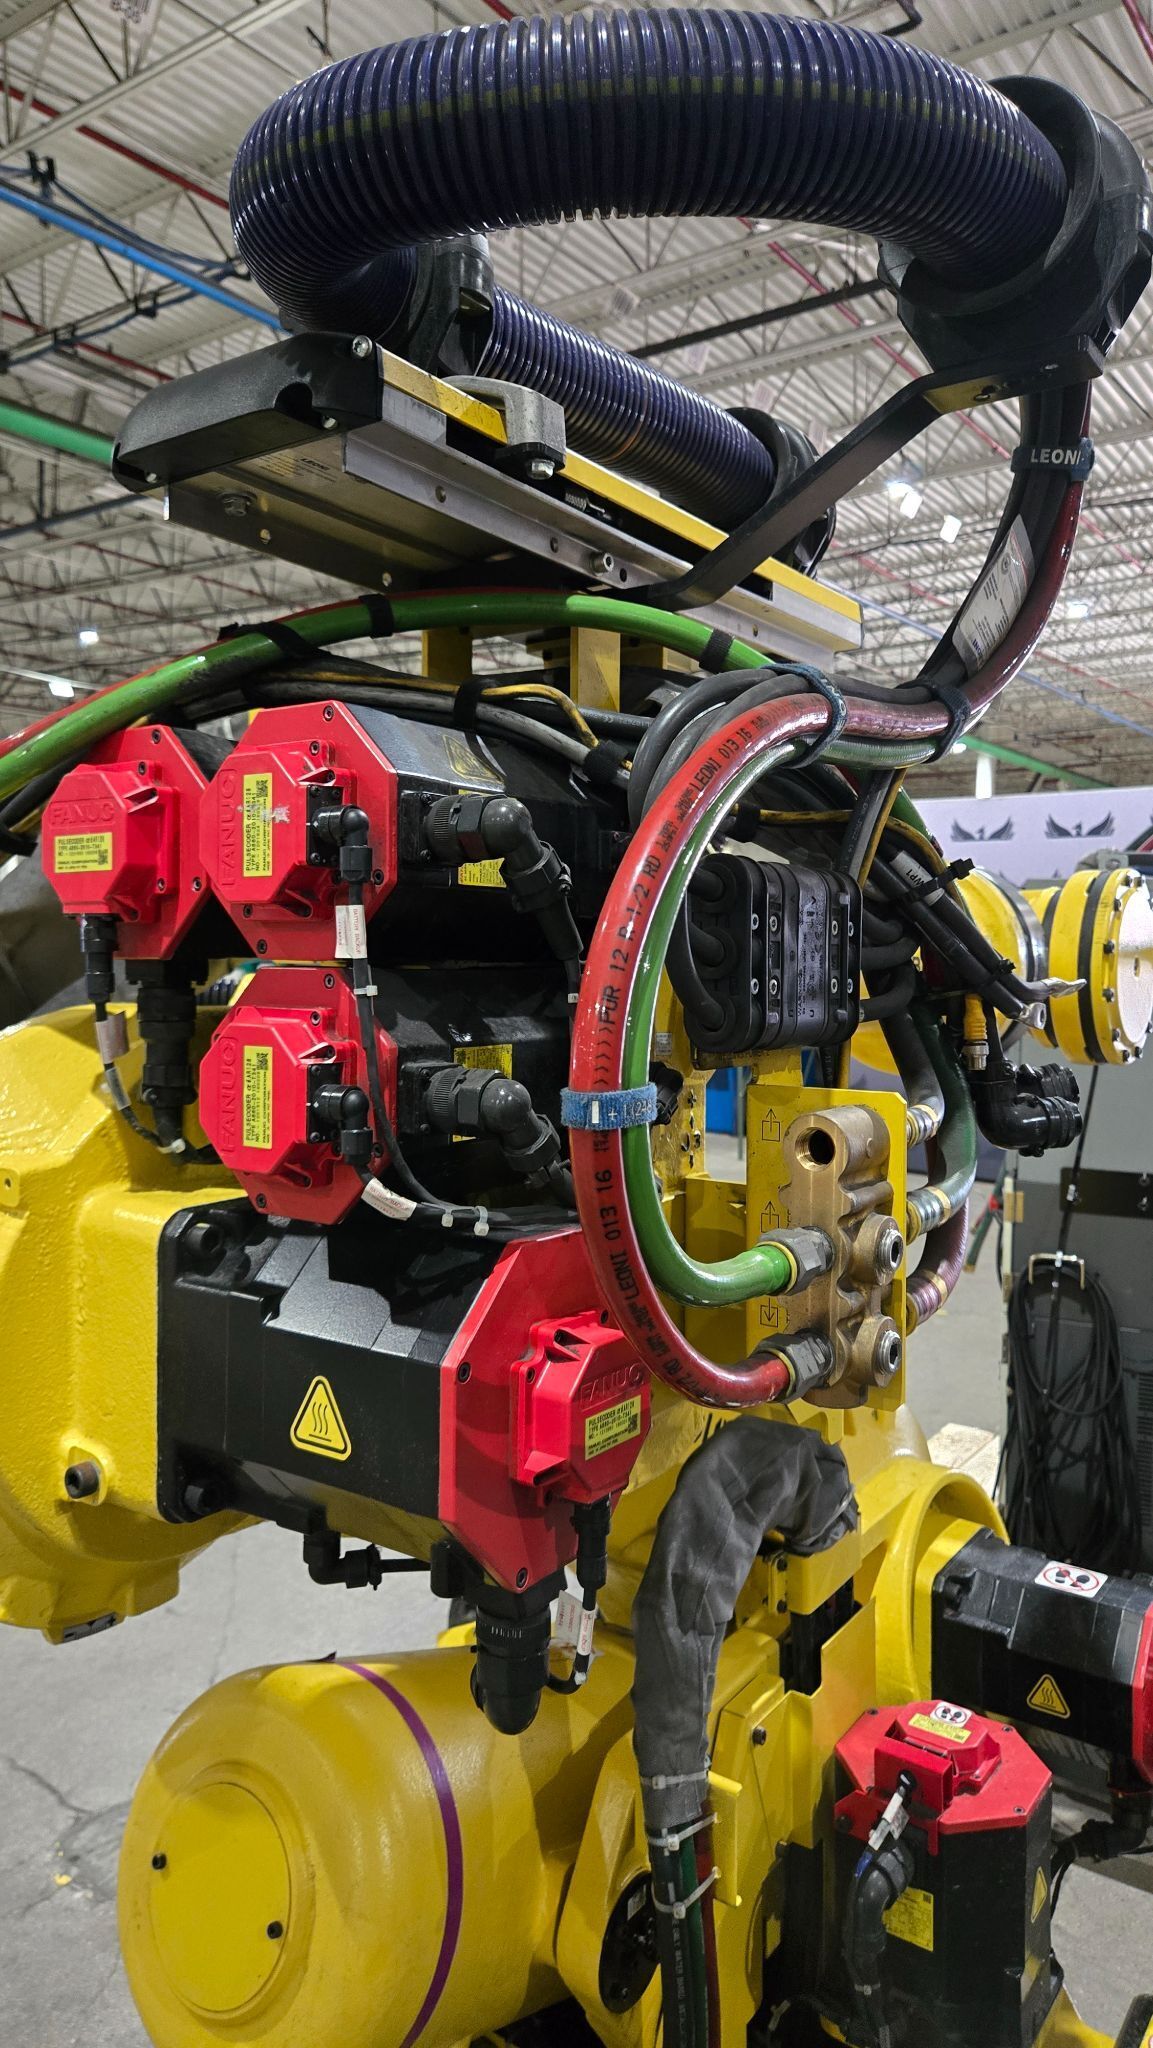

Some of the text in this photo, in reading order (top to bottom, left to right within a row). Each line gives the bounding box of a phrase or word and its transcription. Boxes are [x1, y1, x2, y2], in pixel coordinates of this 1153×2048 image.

[689, 726, 753, 791] LEONI 013 16
[52, 802, 115, 825] FANUC
[221, 776, 235, 879] FANUC
[609, 947, 631, 973] 12
[641, 853, 663, 880] RD
[221, 1043, 236, 1147] FANUC
[595, 1169, 613, 1193] 16
[600, 1206, 621, 1241] 013
[608, 1249, 641, 1302] LEONI
[581, 1363, 641, 1405] FANUC
[589, 1410, 615, 1426] PULSECODER
